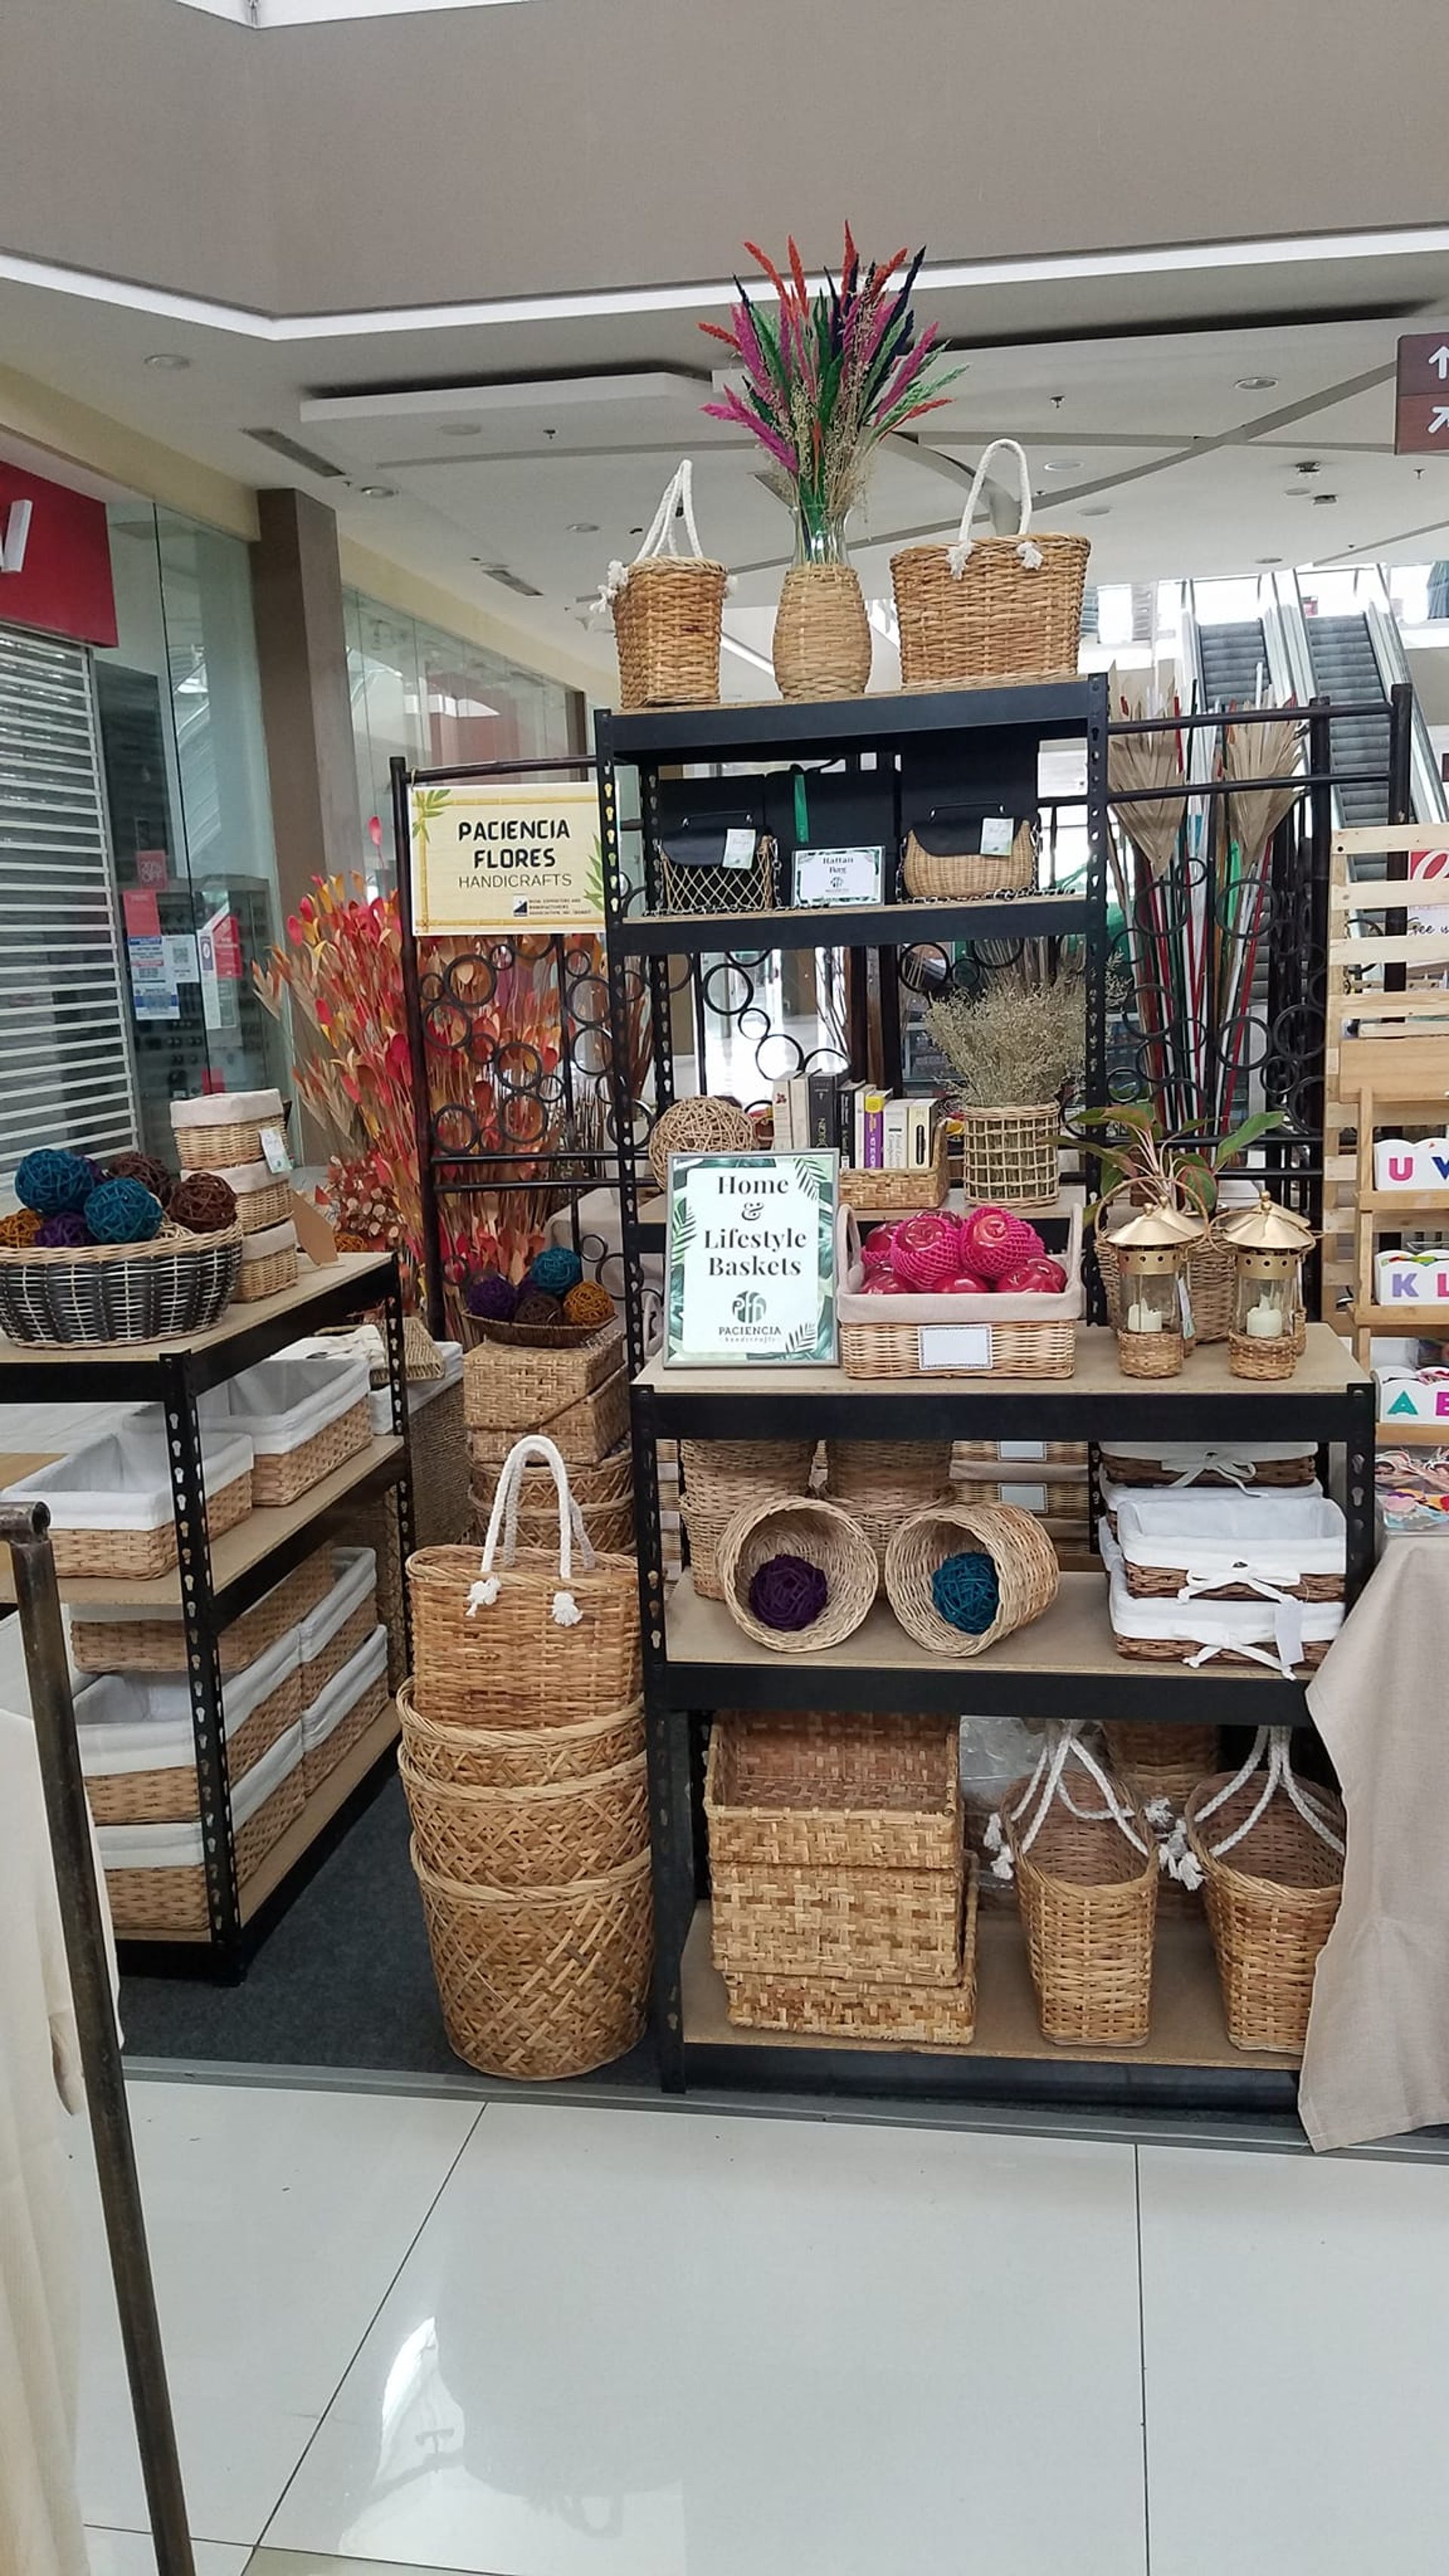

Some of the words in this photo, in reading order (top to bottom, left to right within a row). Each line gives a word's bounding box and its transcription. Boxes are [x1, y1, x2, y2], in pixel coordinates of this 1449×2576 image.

[458, 820, 571, 841] PACIENCIA
[474, 848, 555, 869] FLORES
[823, 857, 854, 865] Rattan
[458, 873, 572, 889] HANDICRAFTS
[1389, 1157, 1414, 1181] U
[718, 1175, 789, 1195] Home
[741, 1202, 764, 1220] &
[704, 1227, 807, 1252] Lifestyle
[709, 1256, 801, 1276] Baskets
[1392, 1273, 1419, 1297] K
[718, 1326, 782, 1335] PACIENCIA
[1387, 1390, 1419, 1415] A
